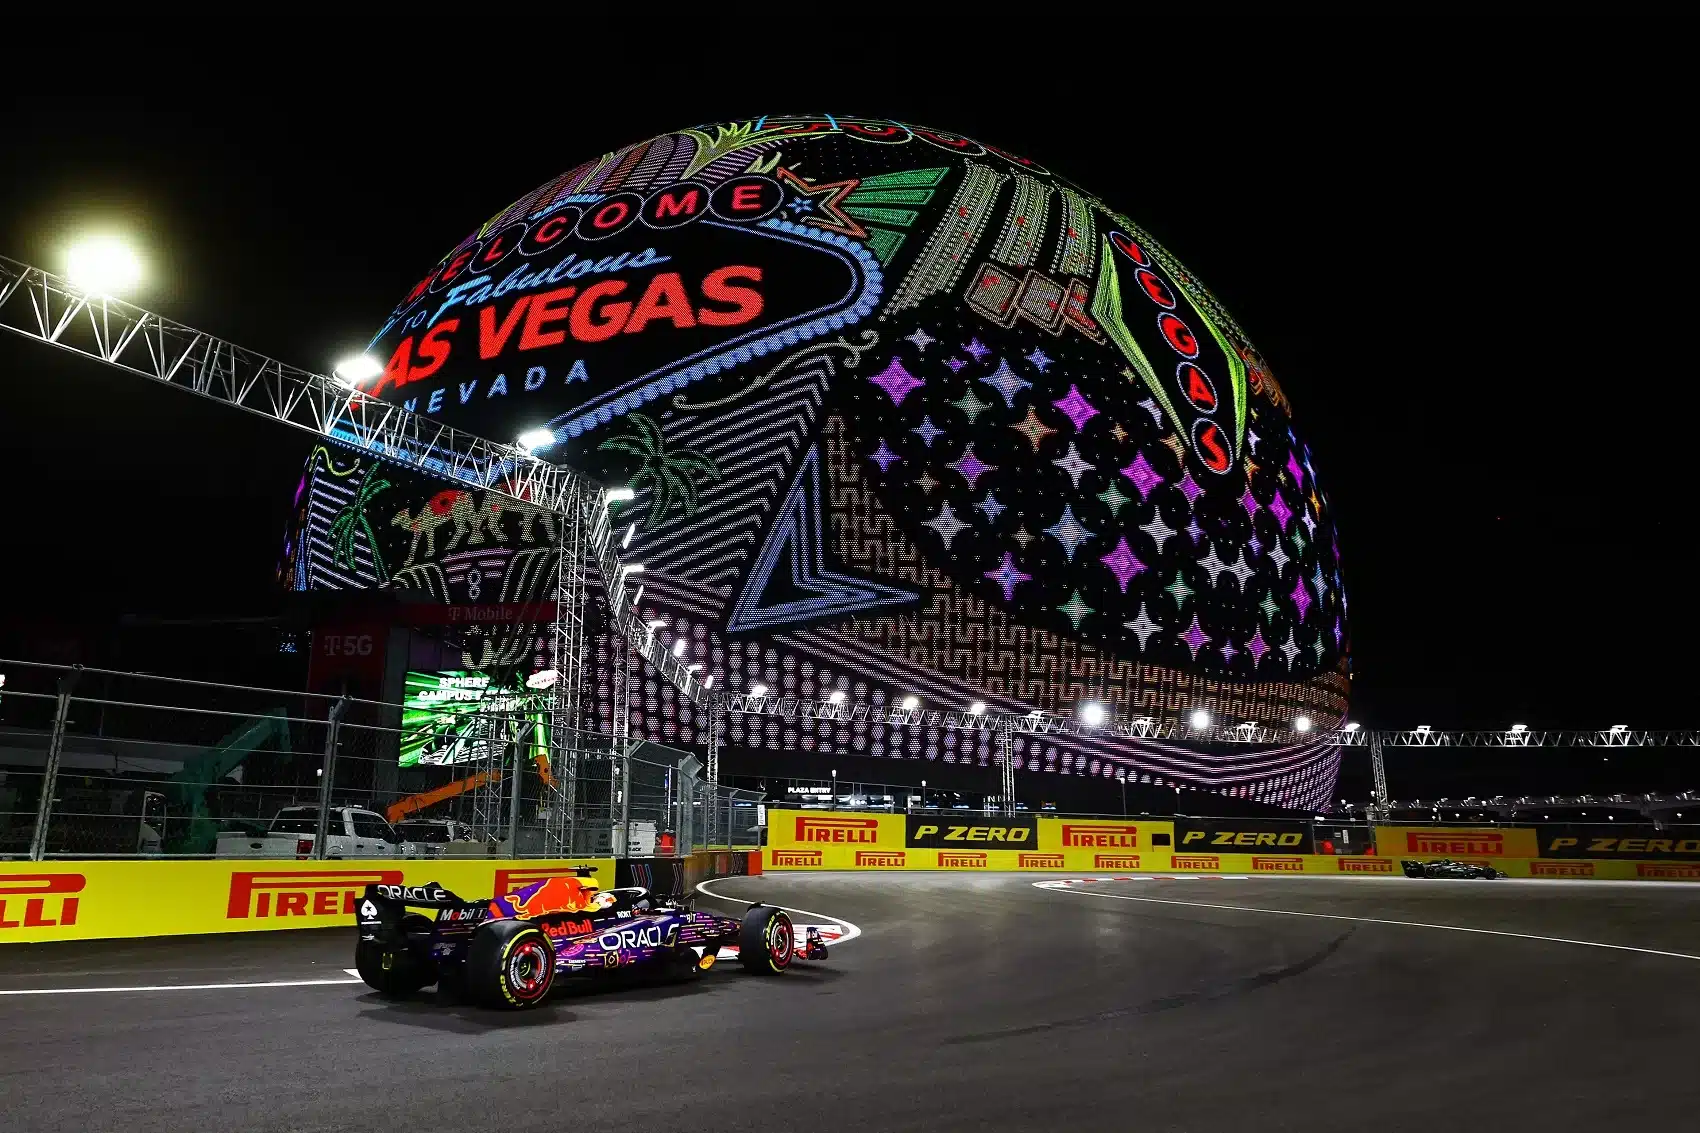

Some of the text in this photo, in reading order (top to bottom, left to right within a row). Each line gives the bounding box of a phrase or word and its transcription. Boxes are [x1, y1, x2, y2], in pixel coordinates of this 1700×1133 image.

[401, 247, 672, 335] TO Fabulous
[351, 264, 765, 411] AS VEGAS
[464, 606, 513, 621] Mobile
[344, 635, 373, 656] 5G
[439, 677, 491, 688] SPHERE
[418, 690, 472, 701] CAMPUS
[795, 816, 879, 844] PIRELLI
[914, 825, 1031, 842] P ZERO
[1062, 824, 1137, 848] PIRELLI
[1182, 831, 1303, 846] P ZERO
[1406, 832, 1504, 855] PIRELLI
[1550, 837, 1700, 853] P ZERO
[772, 850, 823, 866] PIRELLI
[855, 851, 906, 867] PIRELLI
[938, 852, 987, 867] PIRELLI
[1018, 854, 1065, 868] PIRELLI
[1094, 854, 1140, 869] PIRELLI
[1171, 855, 1219, 870] PIRELLI
[1252, 856, 1304, 871] PIRELLI
[1337, 858, 1393, 872] PIRELLI
[226, 871, 404, 919] PIRE
[440, 908, 475, 921] Mobil
[541, 919, 593, 937] Red Bull
